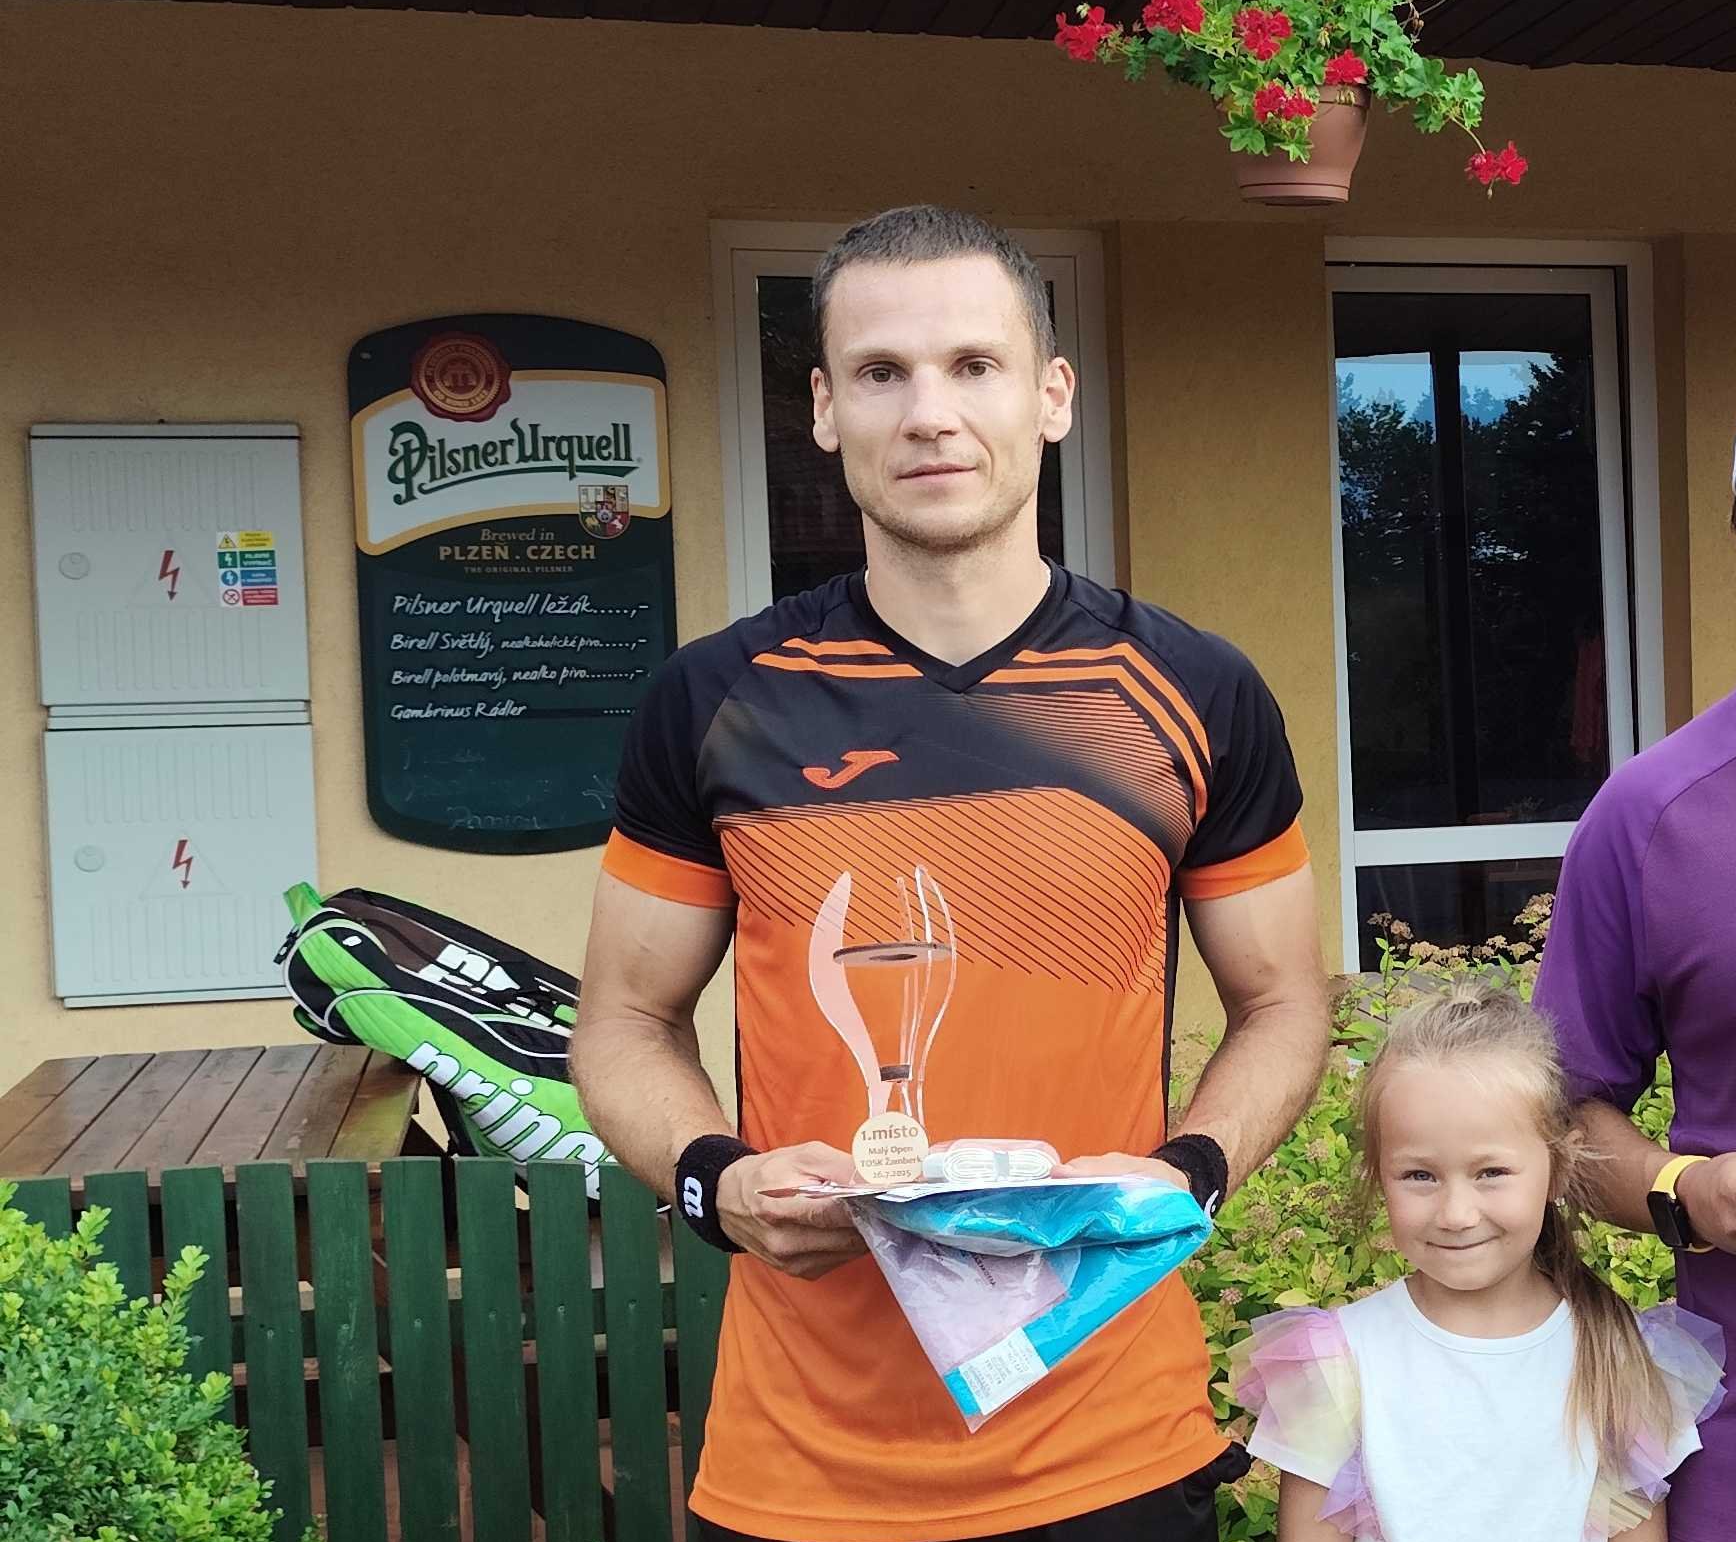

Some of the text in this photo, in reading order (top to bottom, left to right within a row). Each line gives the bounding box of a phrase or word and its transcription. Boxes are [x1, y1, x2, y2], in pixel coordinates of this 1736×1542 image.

[387, 417, 633, 505] Pilsner Urquell
[480, 528, 555, 541] Brewed in
[526, 545, 596, 560] CZECH
[392, 593, 462, 615] Pilsner
[466, 593, 540, 623] Urquell
[390, 632, 440, 651] Birell
[391, 668, 433, 685] Birell
[390, 699, 527, 720] Gambrinus Rádler
[861, 1124, 919, 1141] 1.místo
[890, 1146, 913, 1155] Open
